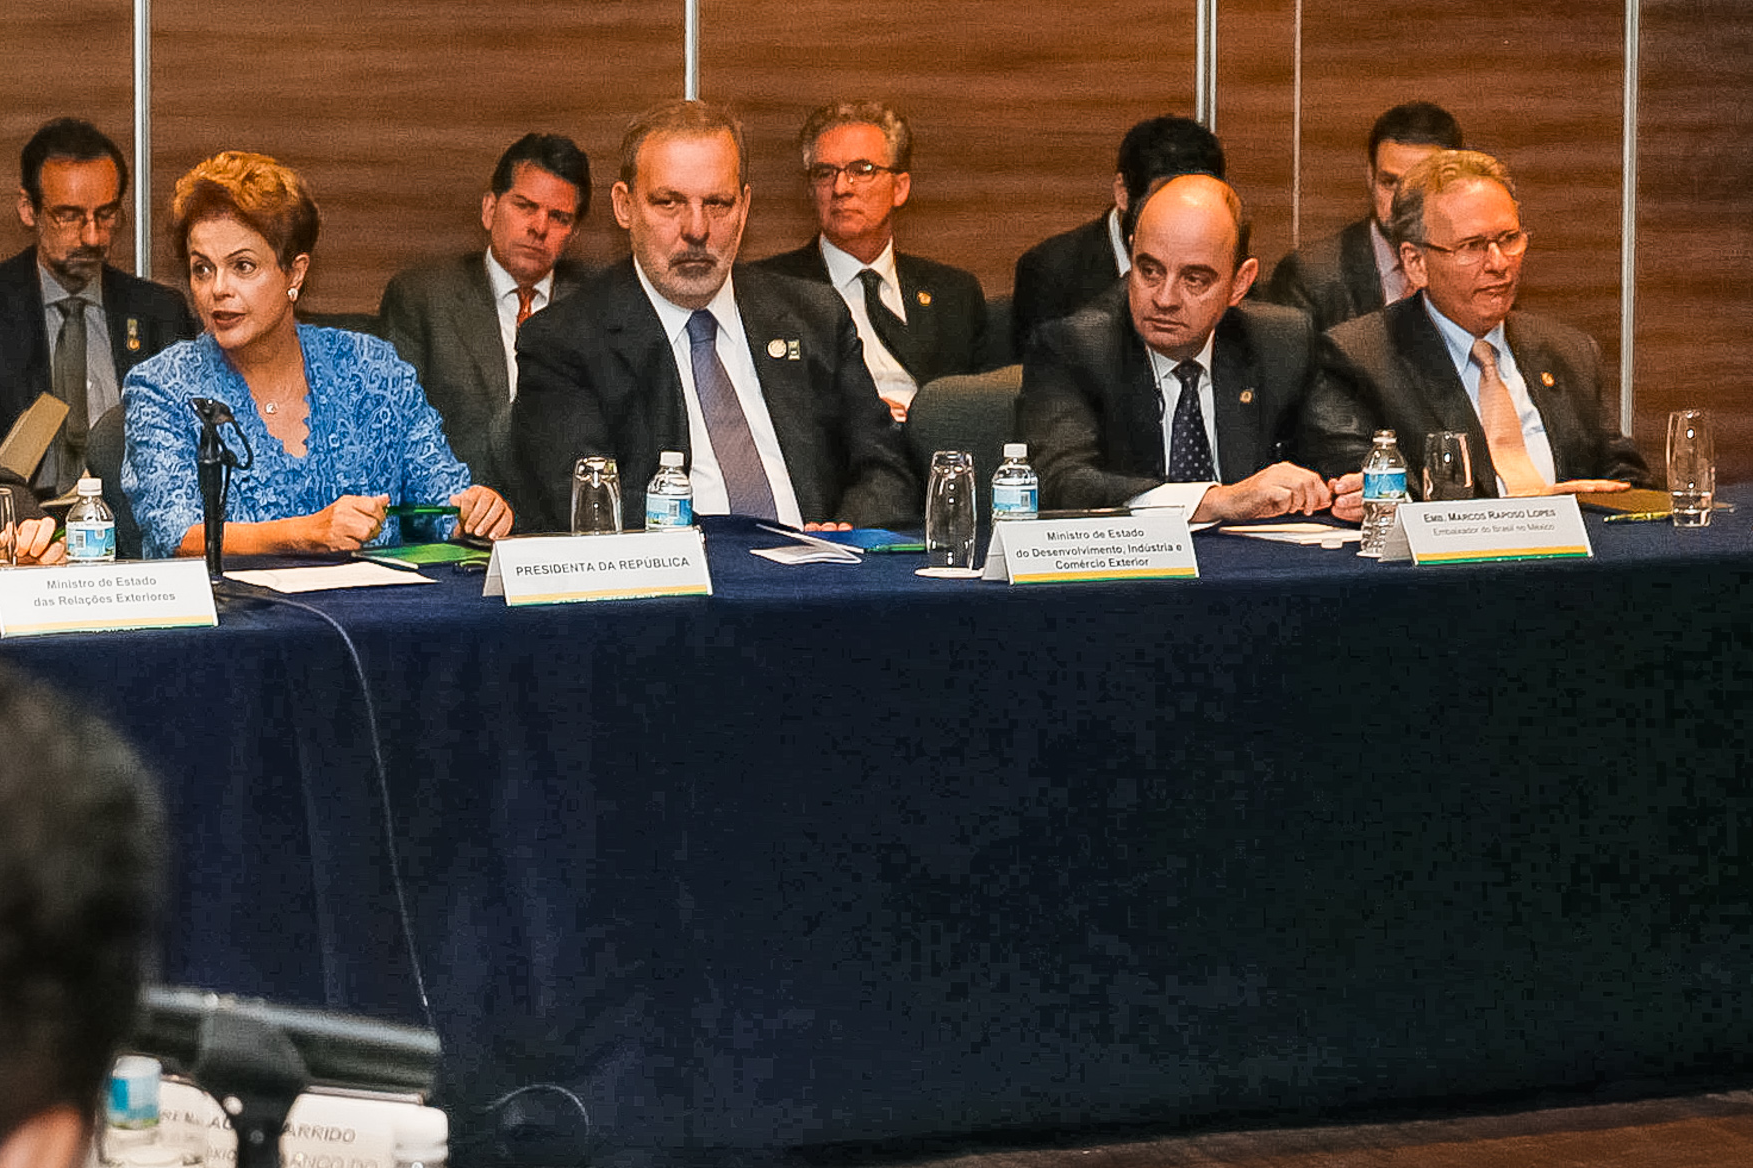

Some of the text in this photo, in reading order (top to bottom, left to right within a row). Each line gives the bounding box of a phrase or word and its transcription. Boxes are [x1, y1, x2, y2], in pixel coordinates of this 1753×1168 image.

[1046, 528, 1144, 541] Ministro de Estado
[1016, 542, 1182, 558] do Desenvolvimento, Indústria e
[516, 556, 690, 577] PRESIDENTA DA REPÚBLICA
[1055, 556, 1149, 570] Comércio Exterior
[47, 575, 157, 590] Ministro de Estado
[33, 591, 176, 607] das Relações Exteriores
[283, 1121, 356, 1143] ARRIDO
